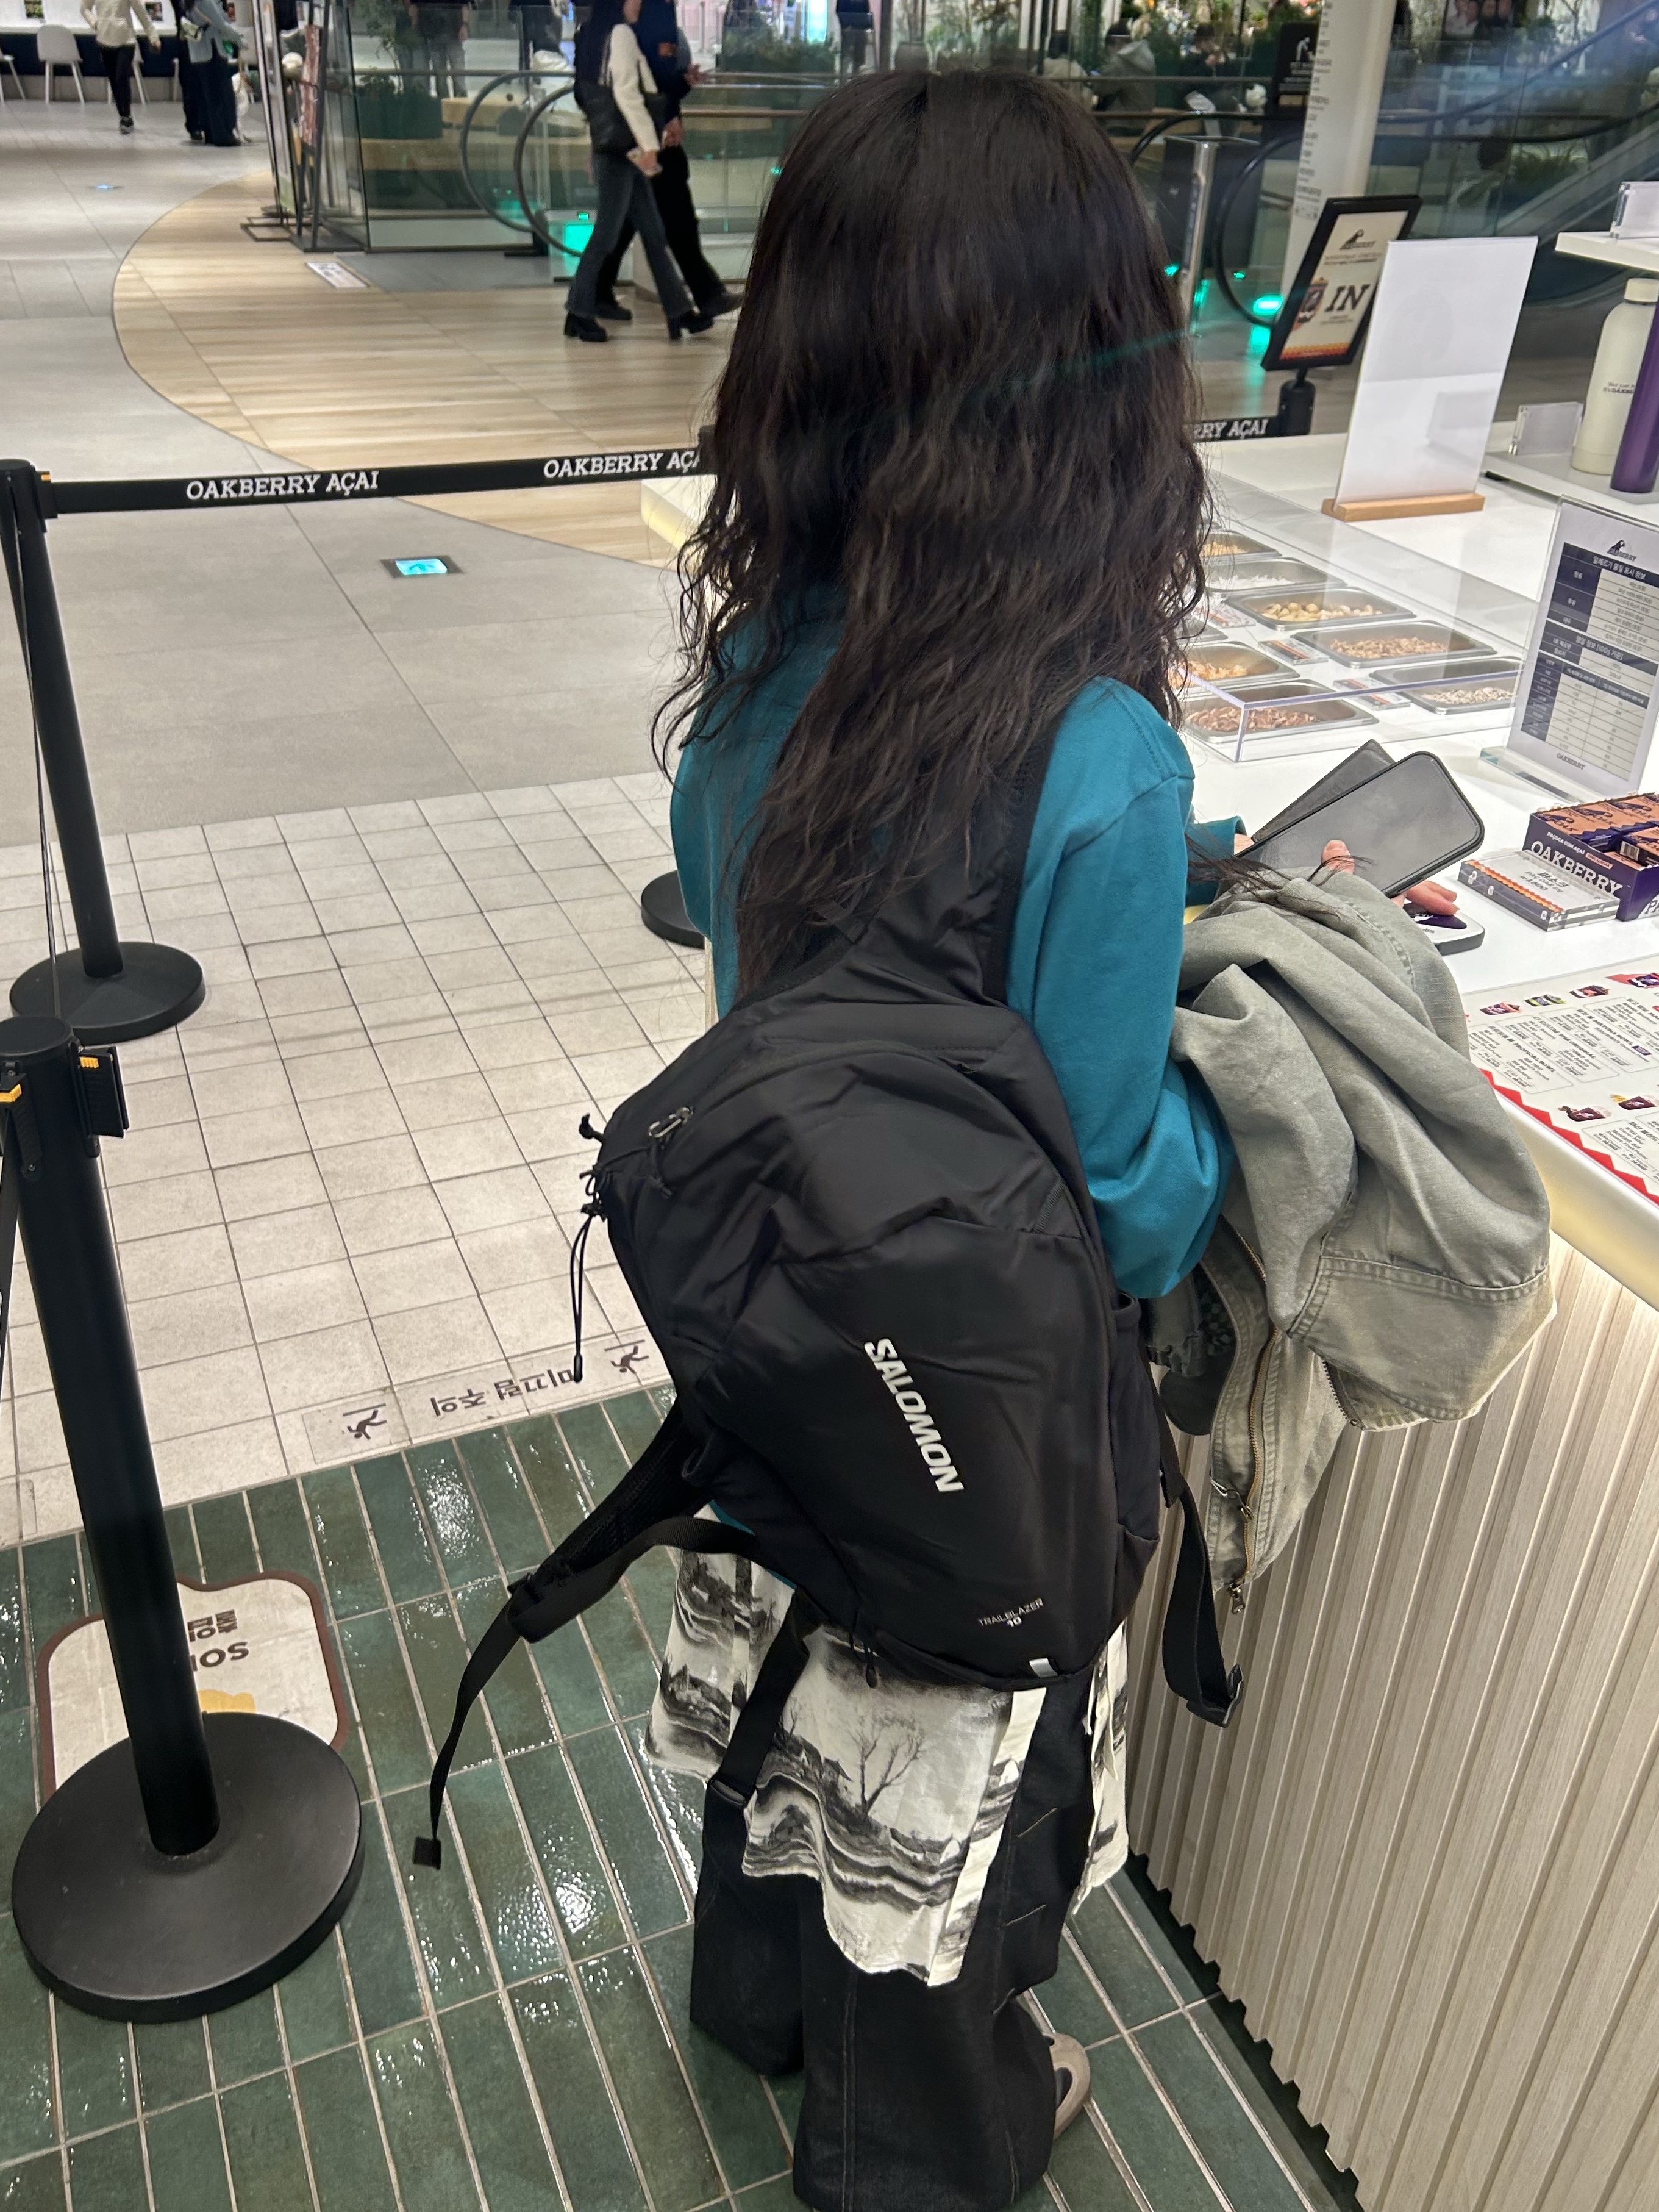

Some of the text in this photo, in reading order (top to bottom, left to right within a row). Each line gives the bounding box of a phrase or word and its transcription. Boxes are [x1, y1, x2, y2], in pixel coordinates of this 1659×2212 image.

[1324, 284, 1371, 312] IN
[543, 453, 664, 478] OAKBERRY
[187, 471, 379, 500] OAKBERRY AÇAI
[1530, 840, 1623, 895] OAKBERRY
[1514, 1042, 1539, 1061] TROPICAL
[1538, 1061, 1555, 1072] BOWL
[430, 1369, 574, 1417] 미끄럼 주의
[864, 1339, 965, 1492] SALOMON
[978, 1598, 1044, 1627] TRAILBLAZER
[1007, 1616, 1022, 1627] 10
